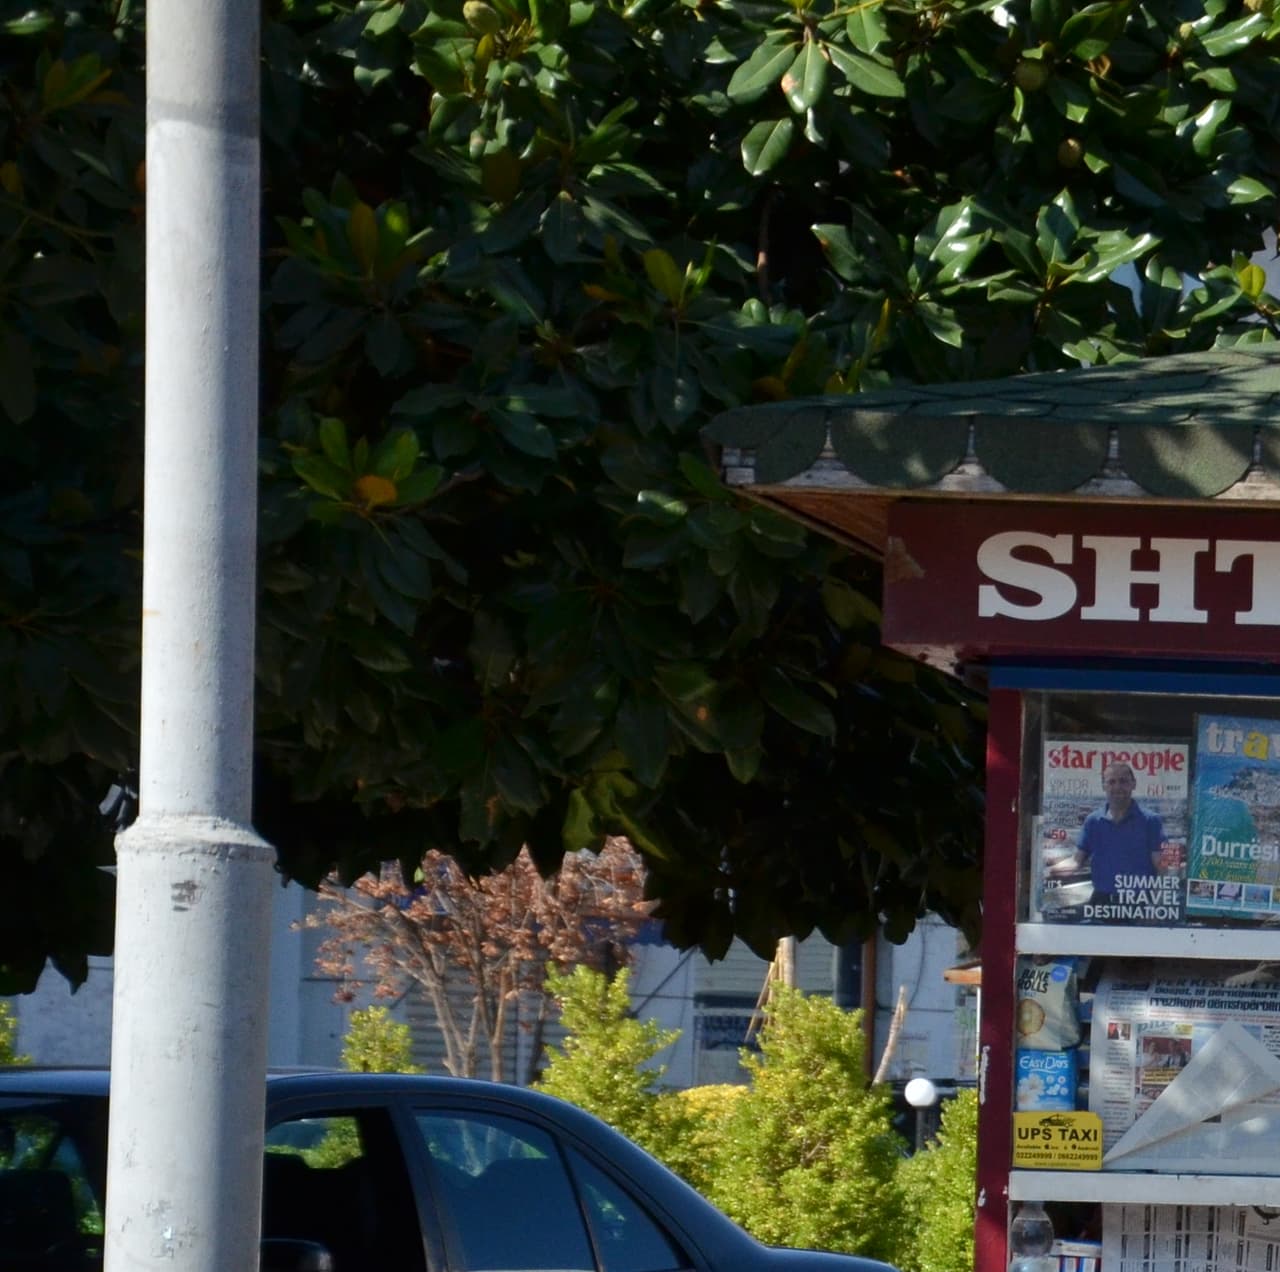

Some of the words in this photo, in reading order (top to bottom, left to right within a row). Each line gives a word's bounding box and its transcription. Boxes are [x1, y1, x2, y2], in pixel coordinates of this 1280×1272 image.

[1048, 744, 1097, 769] star
[1101, 749, 1185, 776] people
[1200, 834, 1279, 861] Durrësi
[1114, 875, 1180, 890] SUMMER
[1117, 889, 1181, 905] TRAVEL
[1083, 904, 1180, 920] DESTINATION
[1018, 1127, 1052, 1141] UPS
[1058, 1128, 1098, 1142] TAXI
